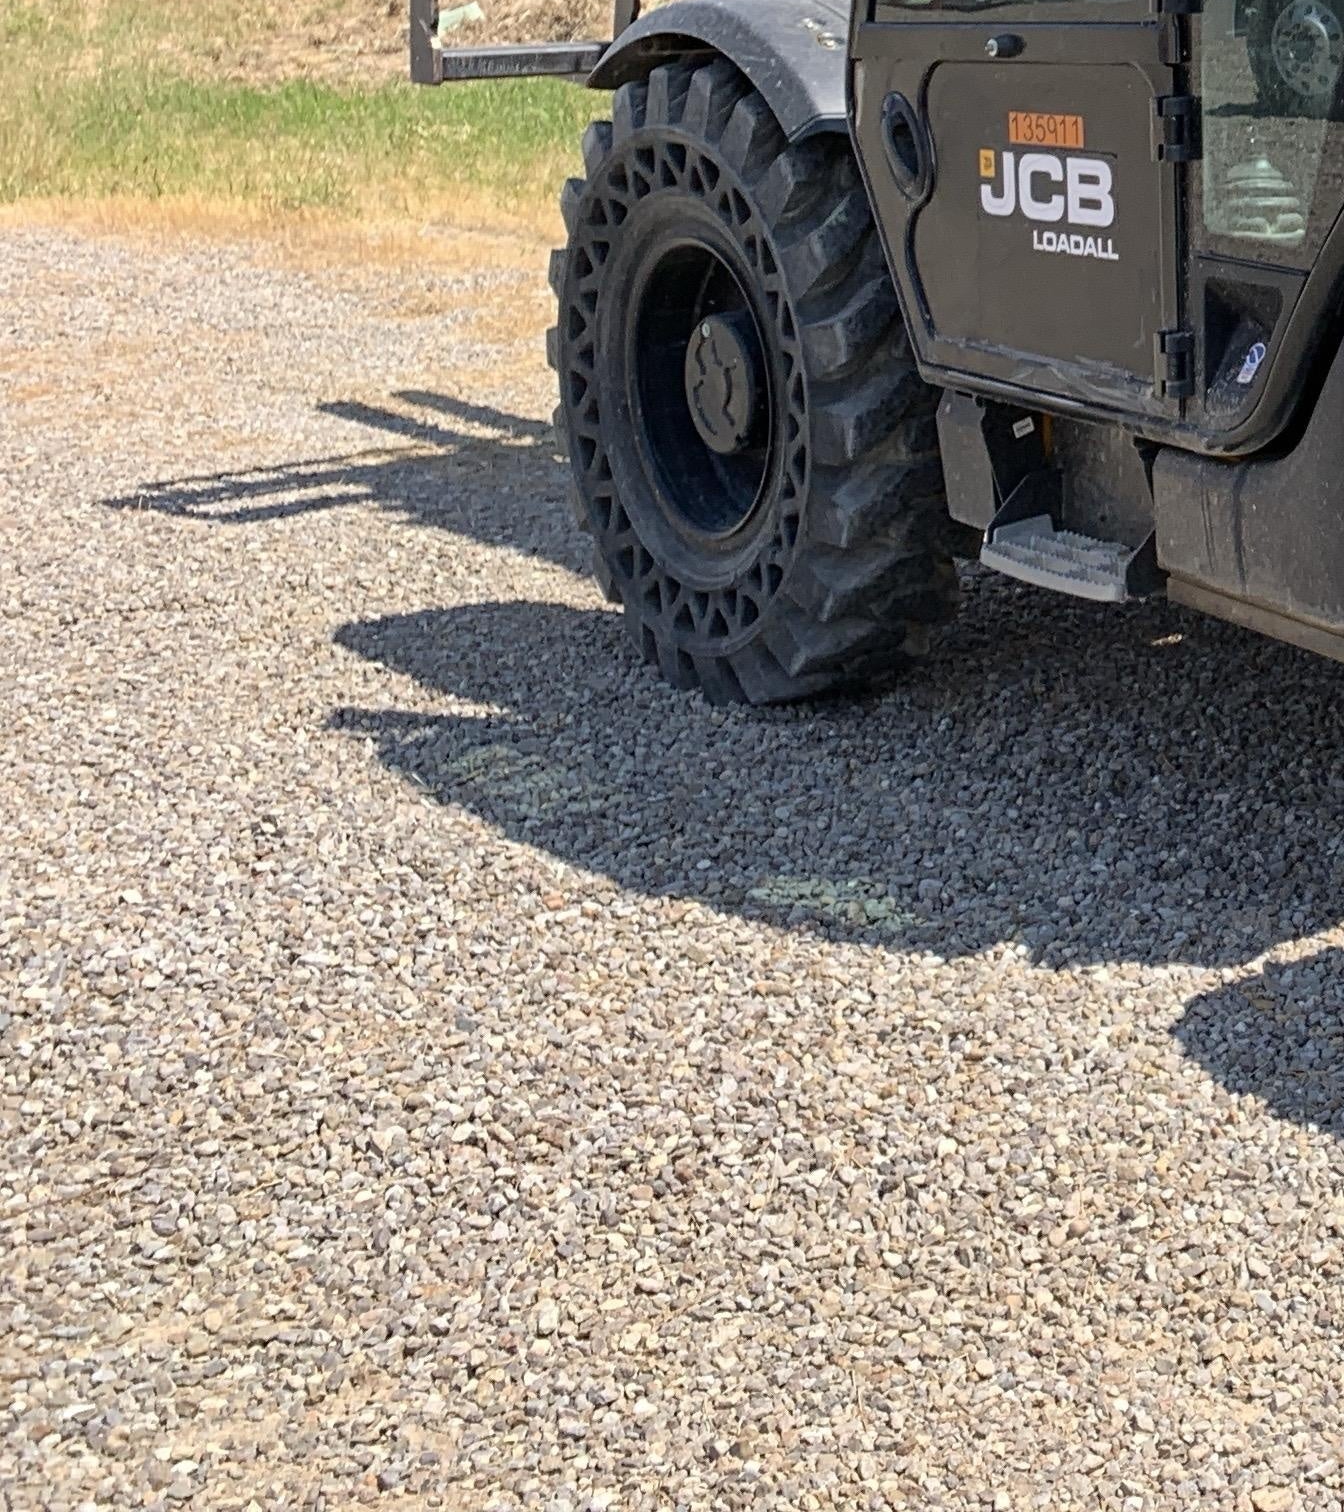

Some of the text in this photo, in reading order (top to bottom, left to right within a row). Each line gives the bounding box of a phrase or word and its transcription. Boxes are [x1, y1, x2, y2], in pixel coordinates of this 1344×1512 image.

[1010, 113, 1080, 146] 135911
[980, 150, 1115, 228] JCB
[1032, 229, 1120, 261] LOADALL
